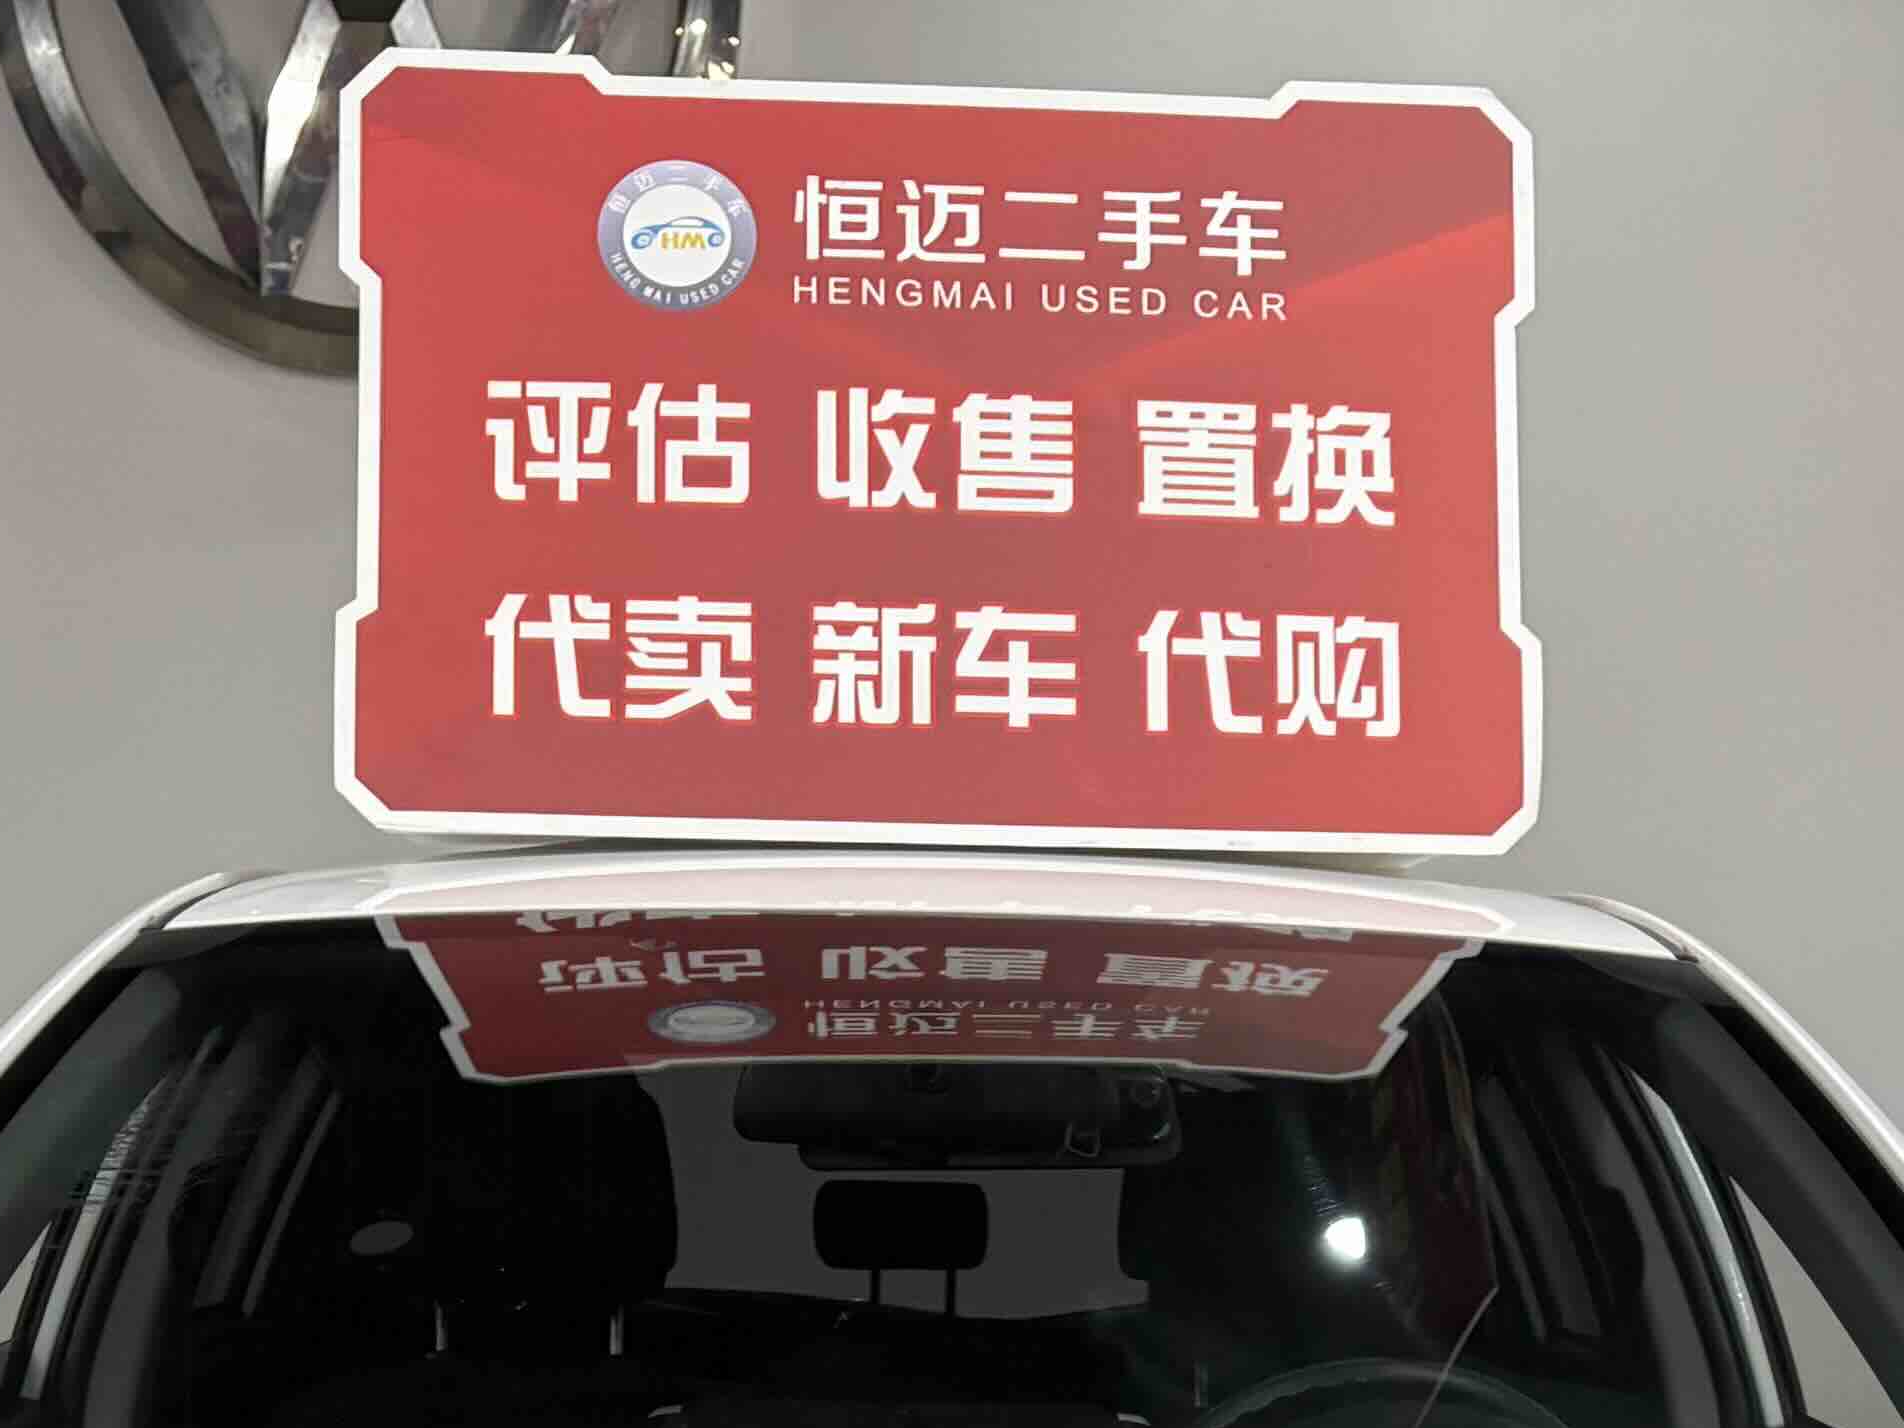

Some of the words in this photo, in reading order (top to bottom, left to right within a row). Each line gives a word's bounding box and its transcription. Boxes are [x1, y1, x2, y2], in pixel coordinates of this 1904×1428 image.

[793, 174, 1287, 277] 恒迈二手车
[793, 275, 1014, 312] HENGMAI
[1041, 282, 1167, 317] USED
[1192, 288, 1288, 322] CAR
[484, 378, 752, 508] 评估
[813, 385, 1074, 514] 收售
[1134, 399, 1398, 528] 置换
[482, 590, 754, 724] 代卖
[811, 600, 1078, 733] 新车
[1136, 606, 1402, 740] 代购
